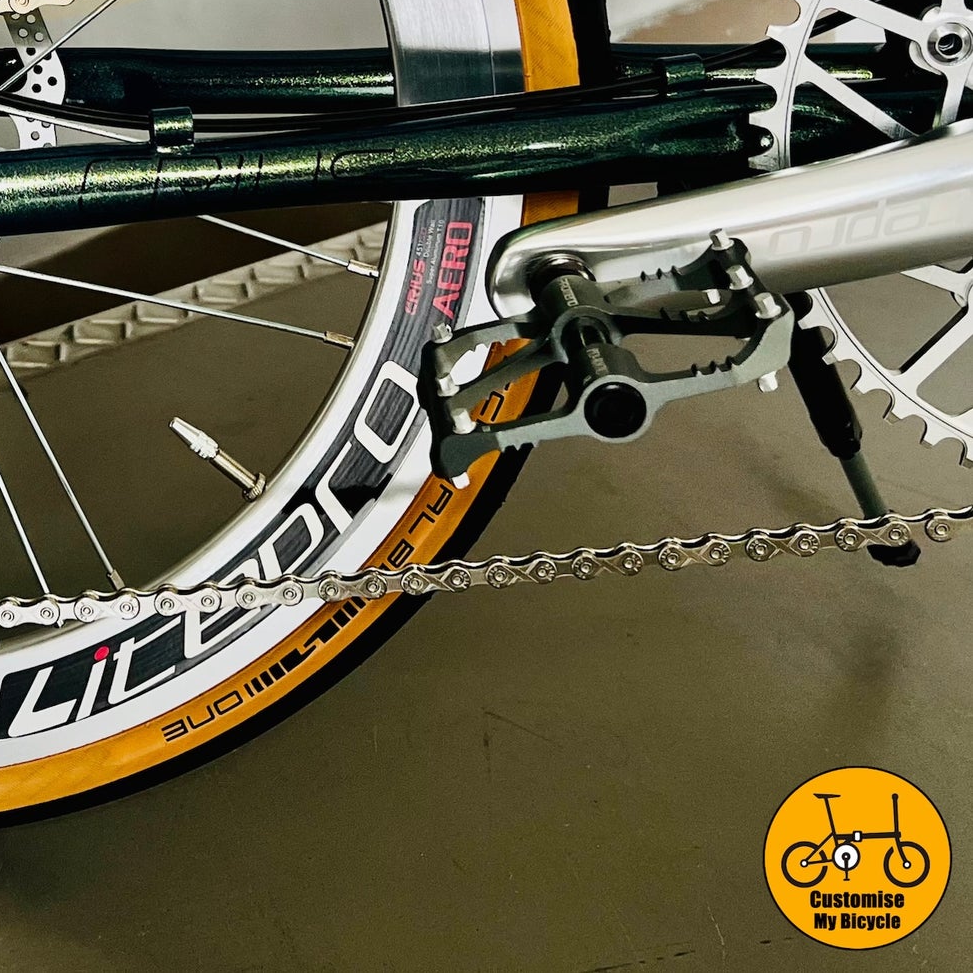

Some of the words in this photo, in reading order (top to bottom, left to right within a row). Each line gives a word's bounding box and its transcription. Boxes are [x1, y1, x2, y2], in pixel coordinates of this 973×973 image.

[405, 258, 426, 316] CRIUS
[432, 221, 473, 320] AERO
[161, 690, 246, 744] ONE
